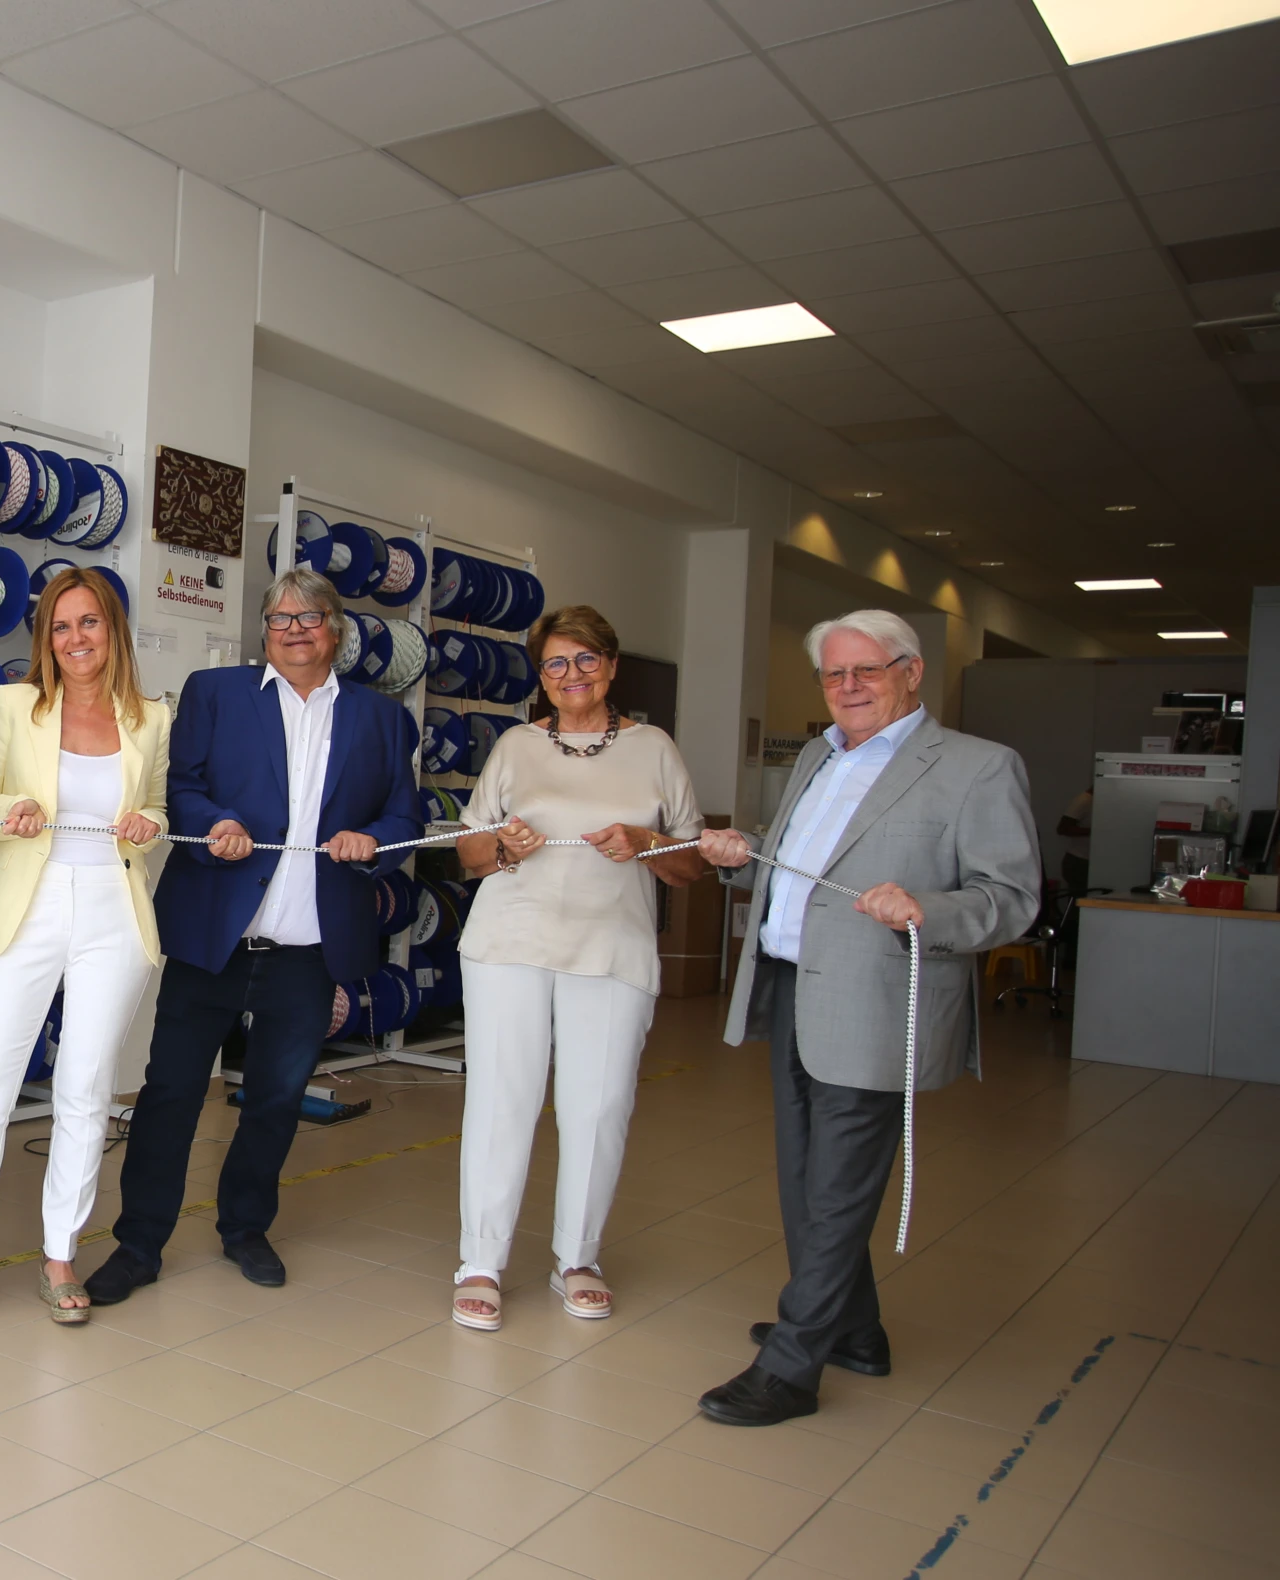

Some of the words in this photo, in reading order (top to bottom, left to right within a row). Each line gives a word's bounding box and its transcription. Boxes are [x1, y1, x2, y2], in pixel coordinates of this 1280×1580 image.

[180, 575, 204, 590] KEINE
[157, 587, 224, 613] Selbstbedienung
[416, 909, 436, 941] Robline
